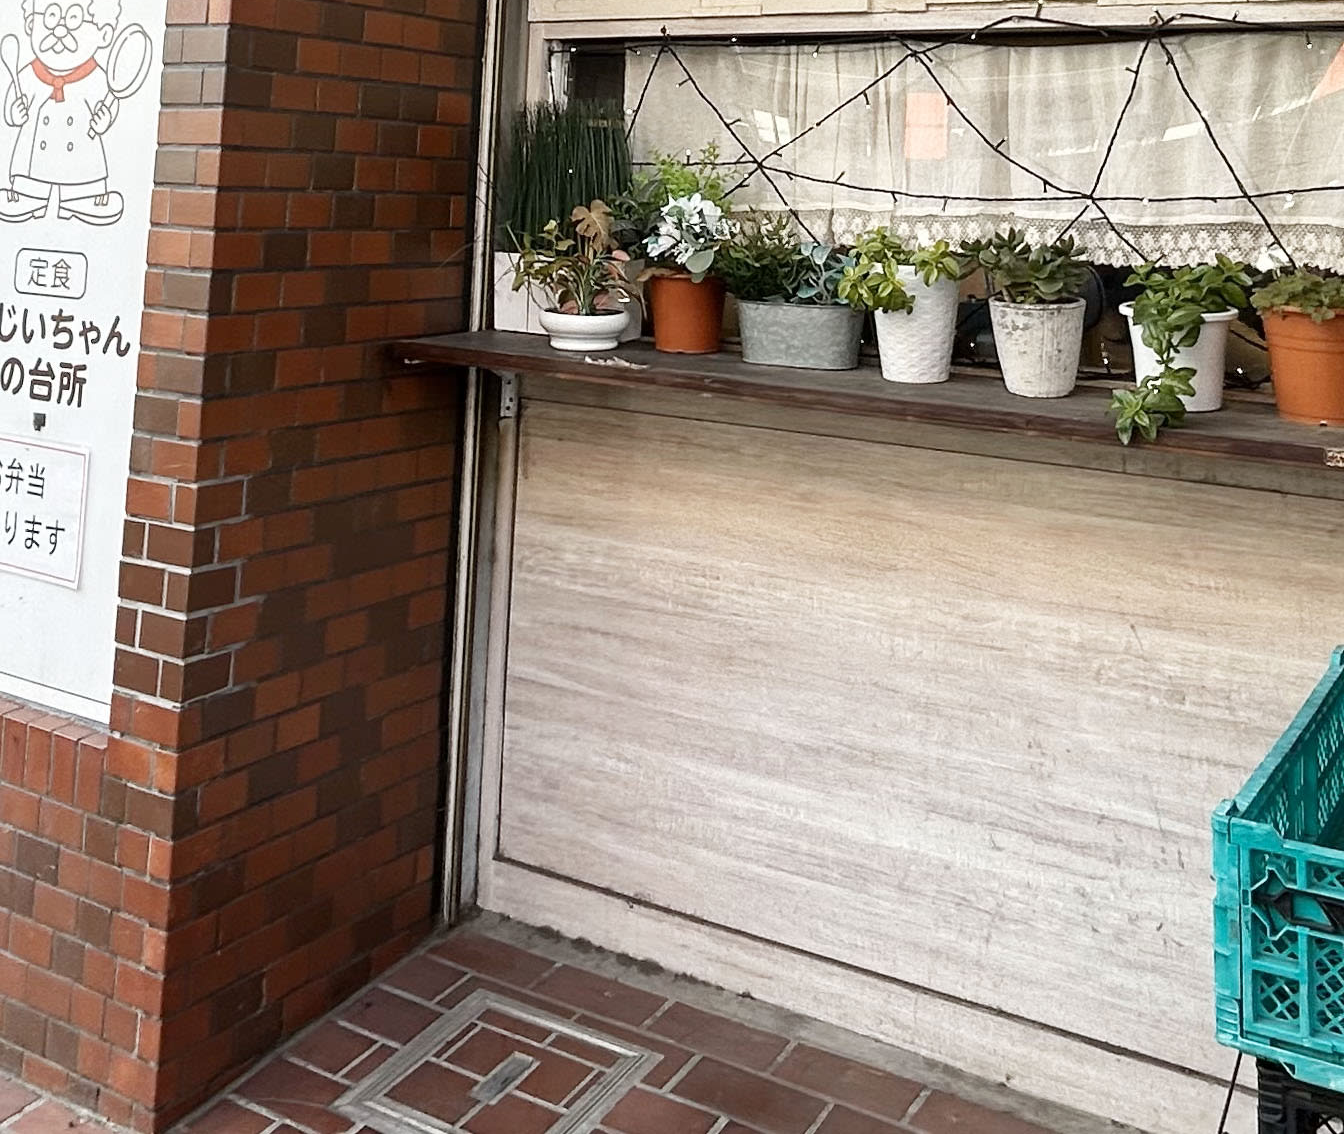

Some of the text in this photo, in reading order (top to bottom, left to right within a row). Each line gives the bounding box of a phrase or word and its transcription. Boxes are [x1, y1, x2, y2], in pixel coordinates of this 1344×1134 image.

[27, 257, 73, 290] 定食
[0, 356, 88, 408] の台所
